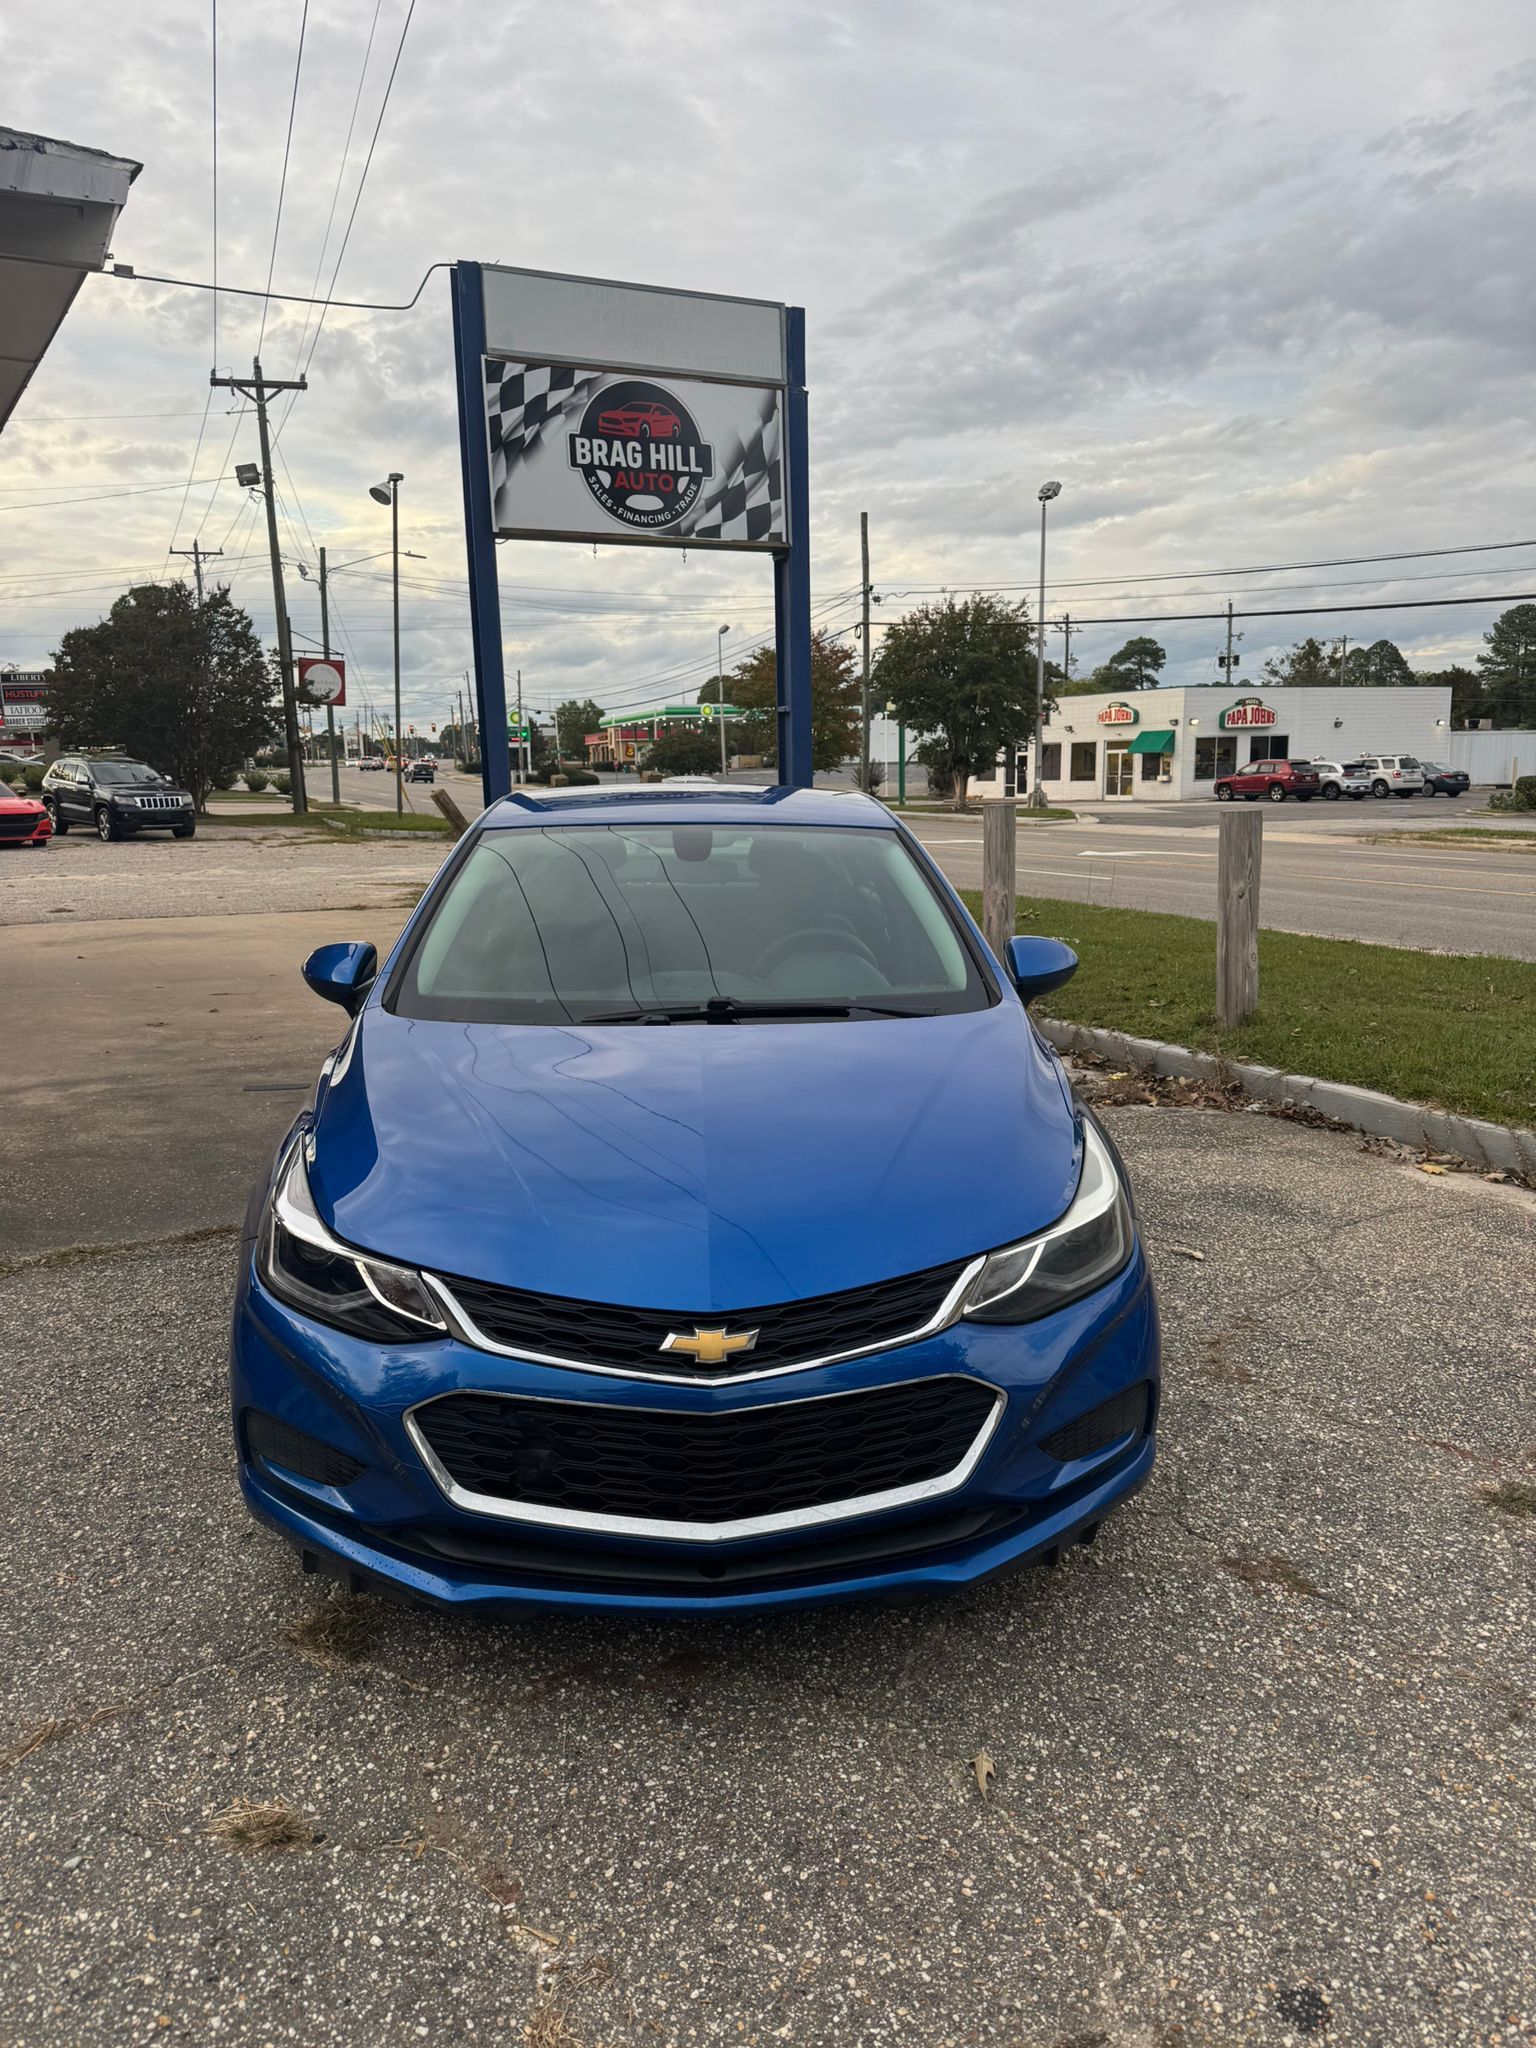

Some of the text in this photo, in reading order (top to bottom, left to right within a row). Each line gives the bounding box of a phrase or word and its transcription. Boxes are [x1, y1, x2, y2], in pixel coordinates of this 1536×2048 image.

[575, 437, 703, 473] BRAG HILL
[614, 471, 675, 492] AUTO
[588, 476, 698, 524] SALES FINANCING TRADE
[1226, 706, 1276, 726] PAPA JOHNS
